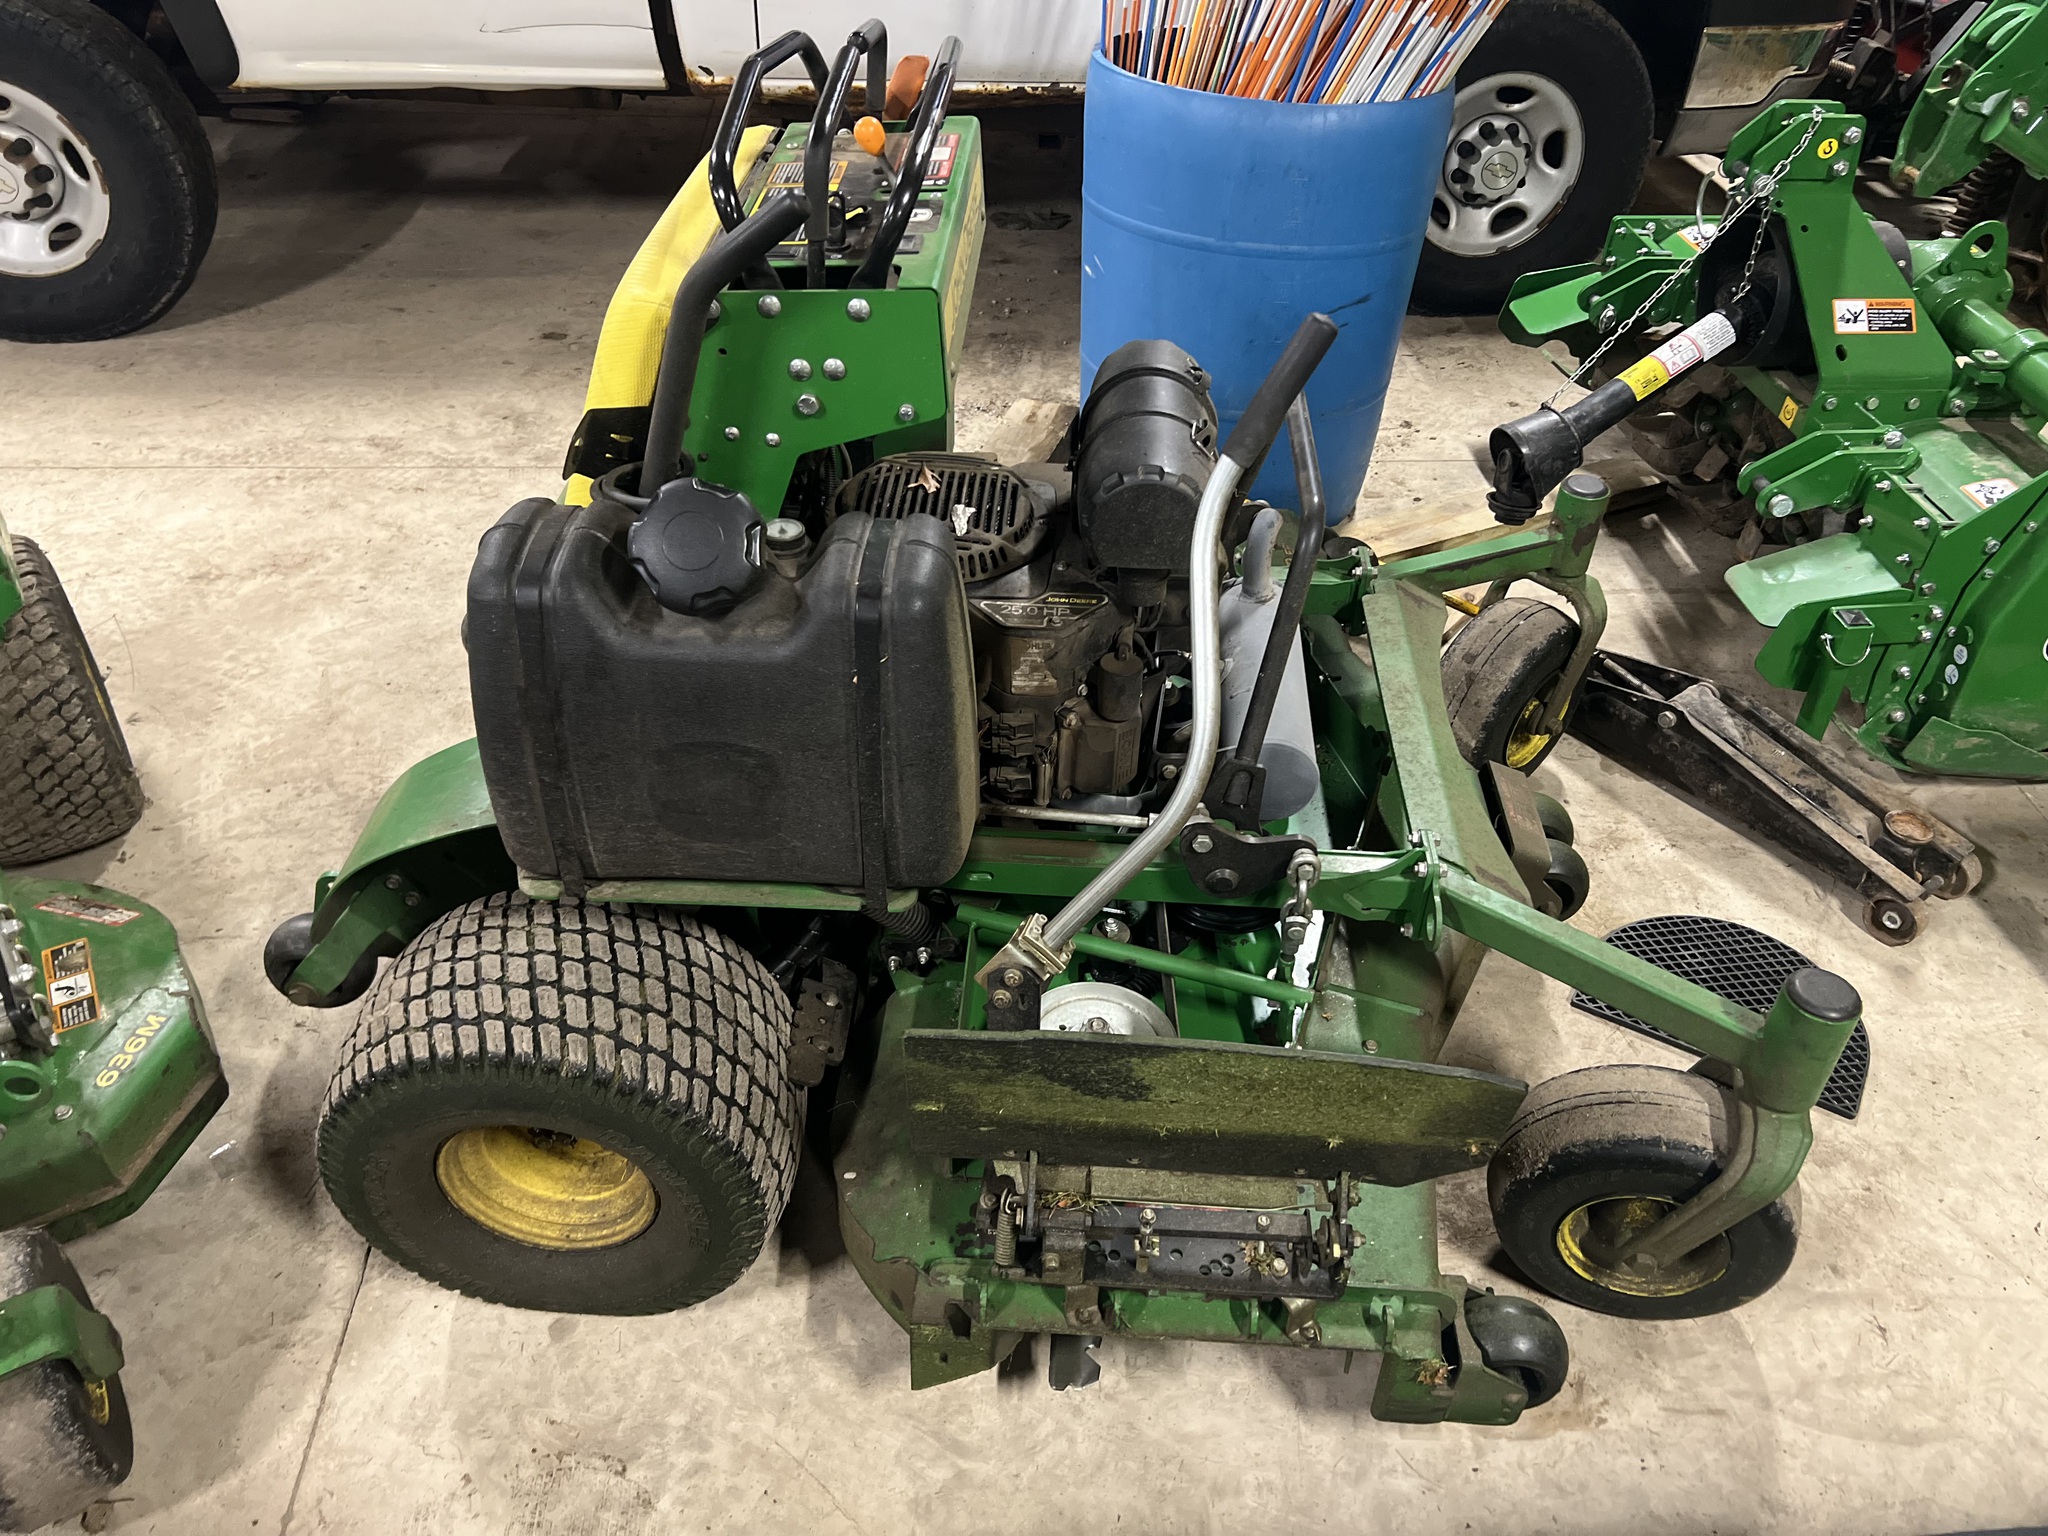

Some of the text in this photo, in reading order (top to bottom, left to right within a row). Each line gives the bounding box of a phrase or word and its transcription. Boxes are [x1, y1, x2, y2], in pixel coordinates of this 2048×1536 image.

[1000, 605, 1071, 616] 25.0 HP
[96, 1013, 168, 1088] 636M
